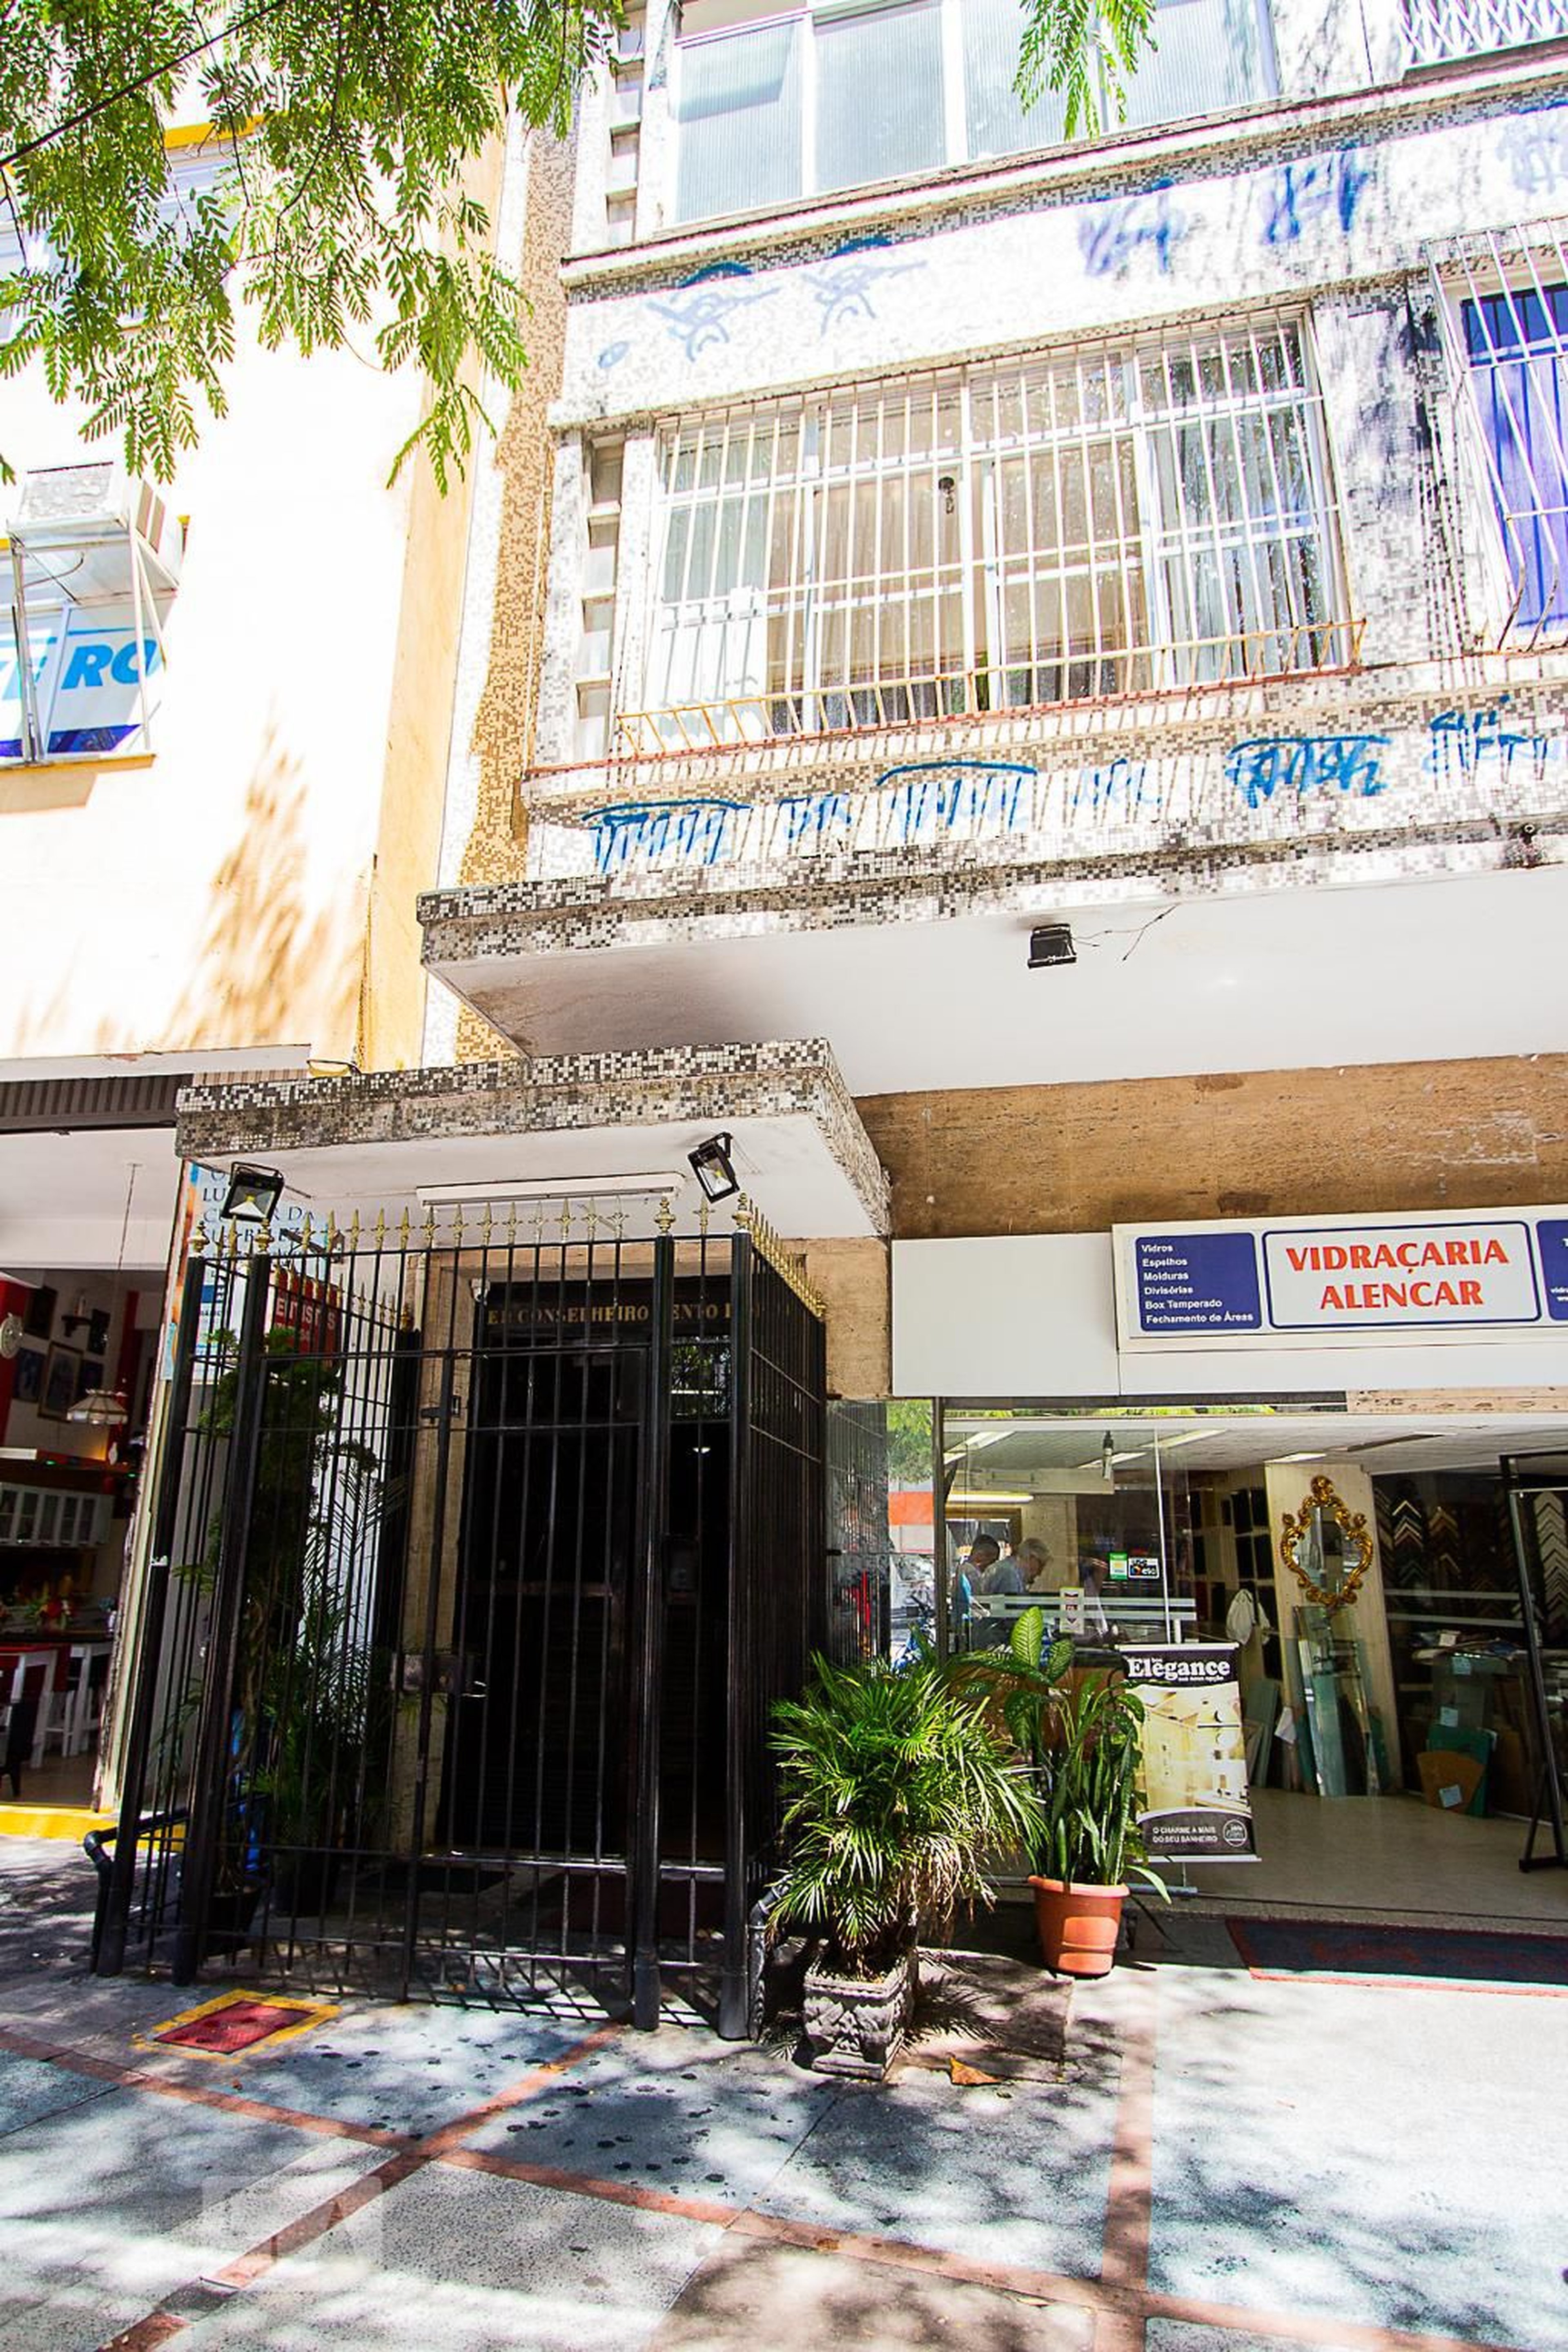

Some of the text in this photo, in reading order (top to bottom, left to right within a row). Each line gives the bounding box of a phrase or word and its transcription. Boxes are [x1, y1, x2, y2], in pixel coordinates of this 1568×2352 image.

[1142, 1245, 1174, 1253] Vidros
[1286, 1239, 1509, 1274] VIDRAÇARIA
[1143, 1258, 1188, 1268] Espelhos
[1143, 1272, 1189, 1281] Molduras
[1144, 1286, 1194, 1295] Divisórias
[1320, 1280, 1484, 1310] ALENCAR
[1145, 1299, 1223, 1310] Box Temperado
[1146, 1311, 1254, 1324] Fechamento de Áreas
